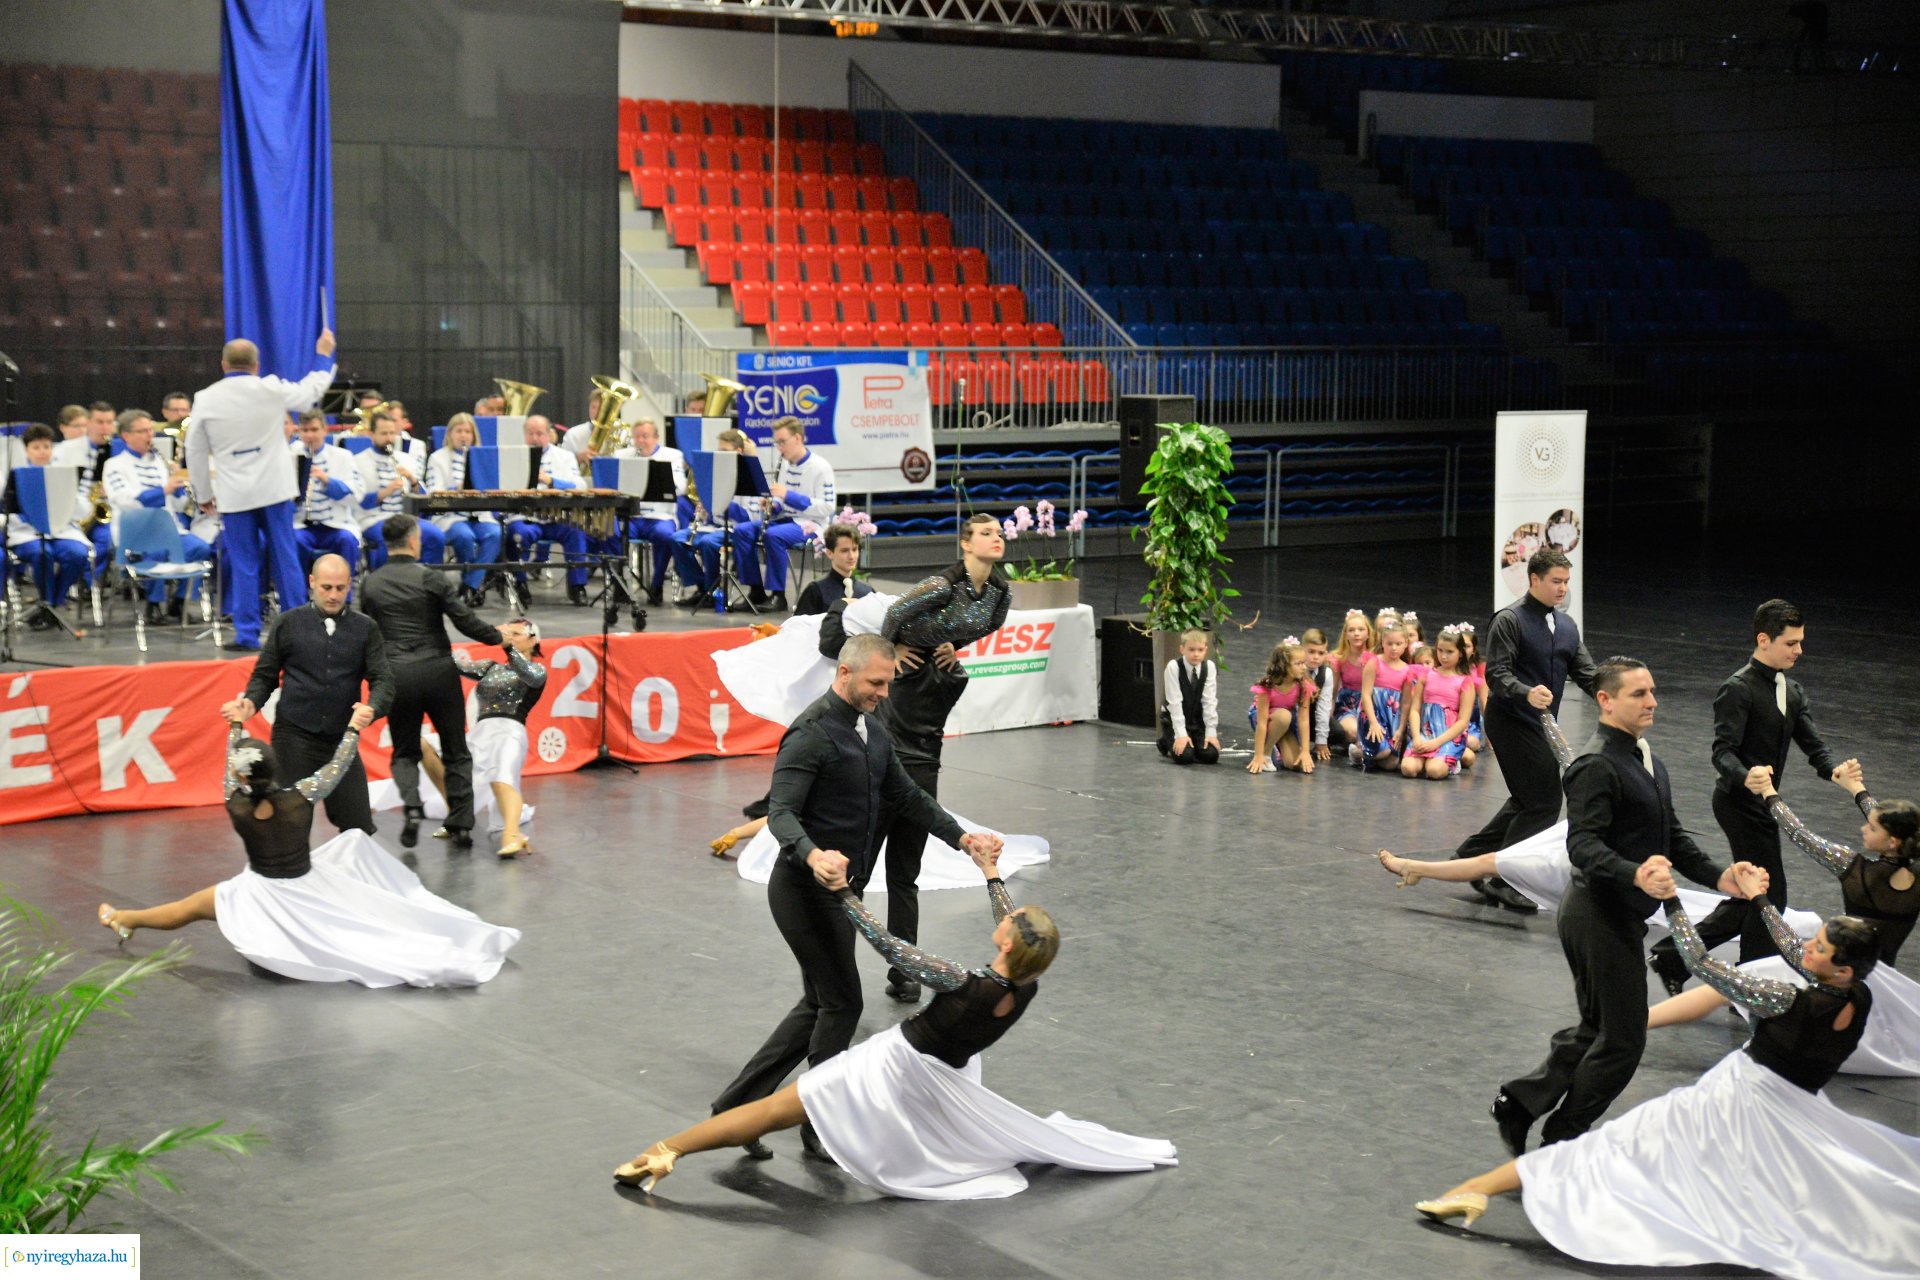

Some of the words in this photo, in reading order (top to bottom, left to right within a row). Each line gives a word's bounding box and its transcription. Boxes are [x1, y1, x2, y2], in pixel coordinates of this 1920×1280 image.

[767, 355, 796, 368] SENIO
[743, 384, 820, 415] SENIO
[863, 376, 904, 409] Pietra
[851, 414, 920, 428] CSEMPEBOLT
[862, 432, 909, 440] www.pietra.hu
